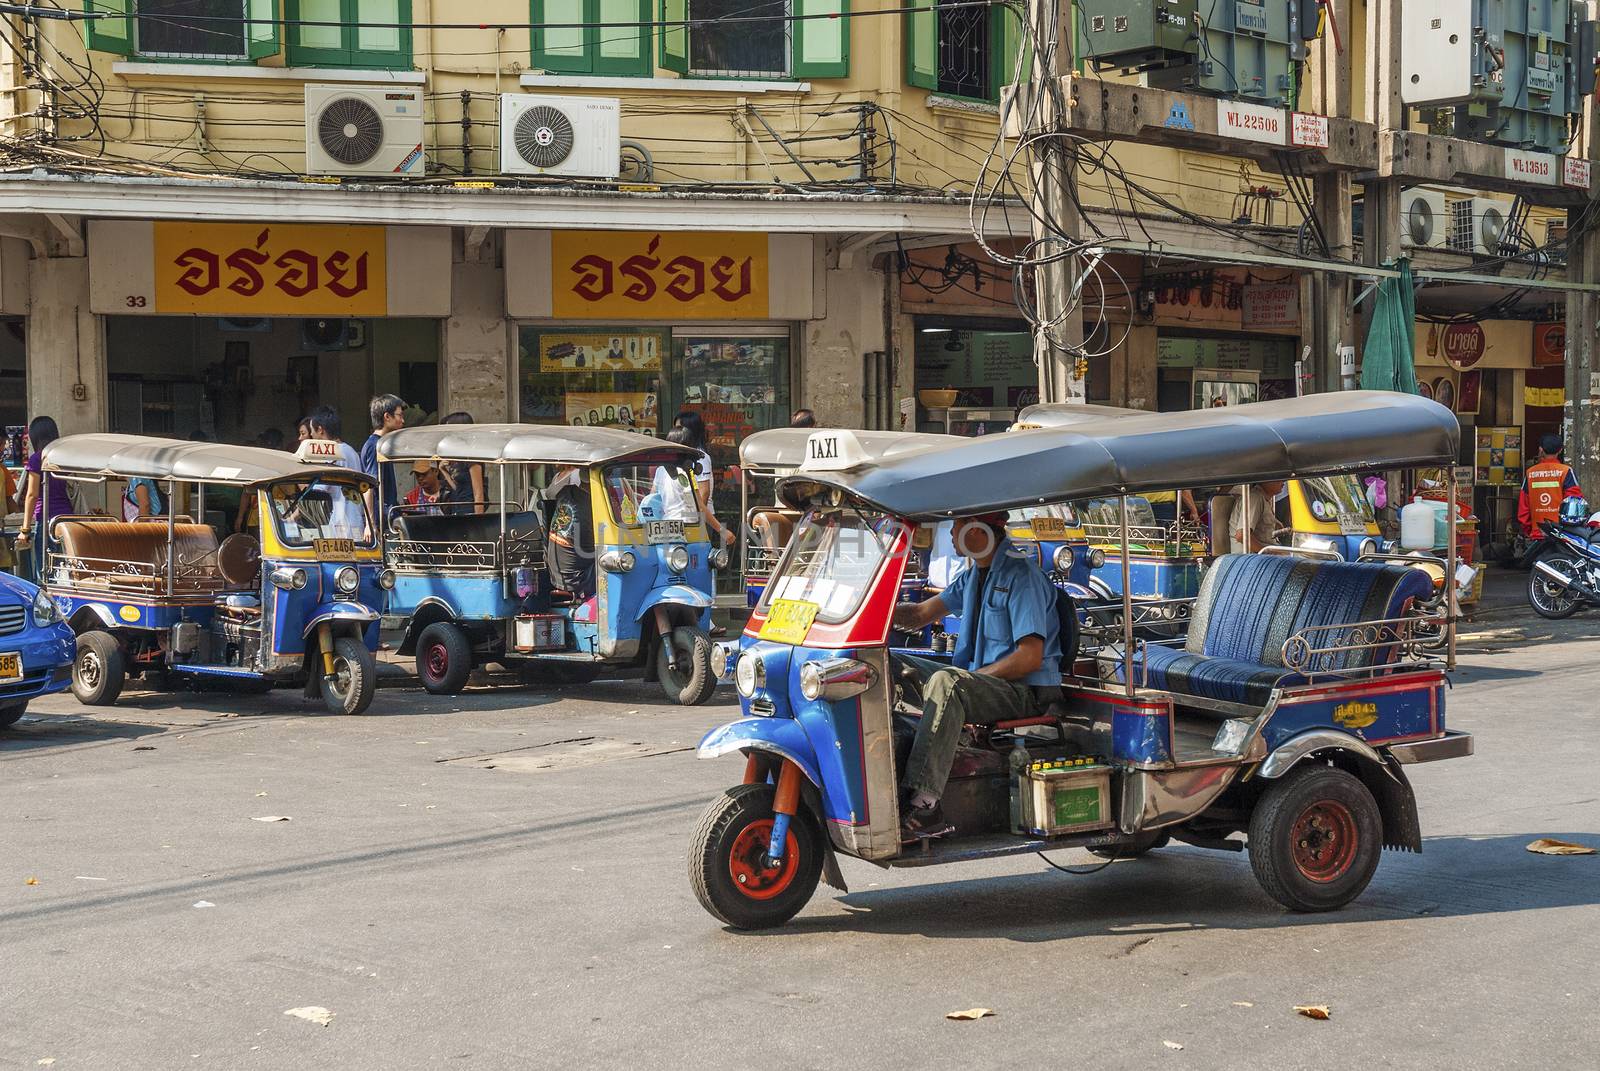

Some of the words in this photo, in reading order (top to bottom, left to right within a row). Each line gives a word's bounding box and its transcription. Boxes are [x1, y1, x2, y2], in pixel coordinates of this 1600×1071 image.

[1227, 111, 1242, 128] WL
[1243, 114, 1279, 133] 22508
[1525, 160, 1549, 176] 13513
[173, 228, 370, 298] อร่อย
[571, 234, 753, 302] อร่อย
[125, 296, 147, 308] 33
[309, 443, 336, 456] TAXI
[809, 437, 839, 459] TAXI
